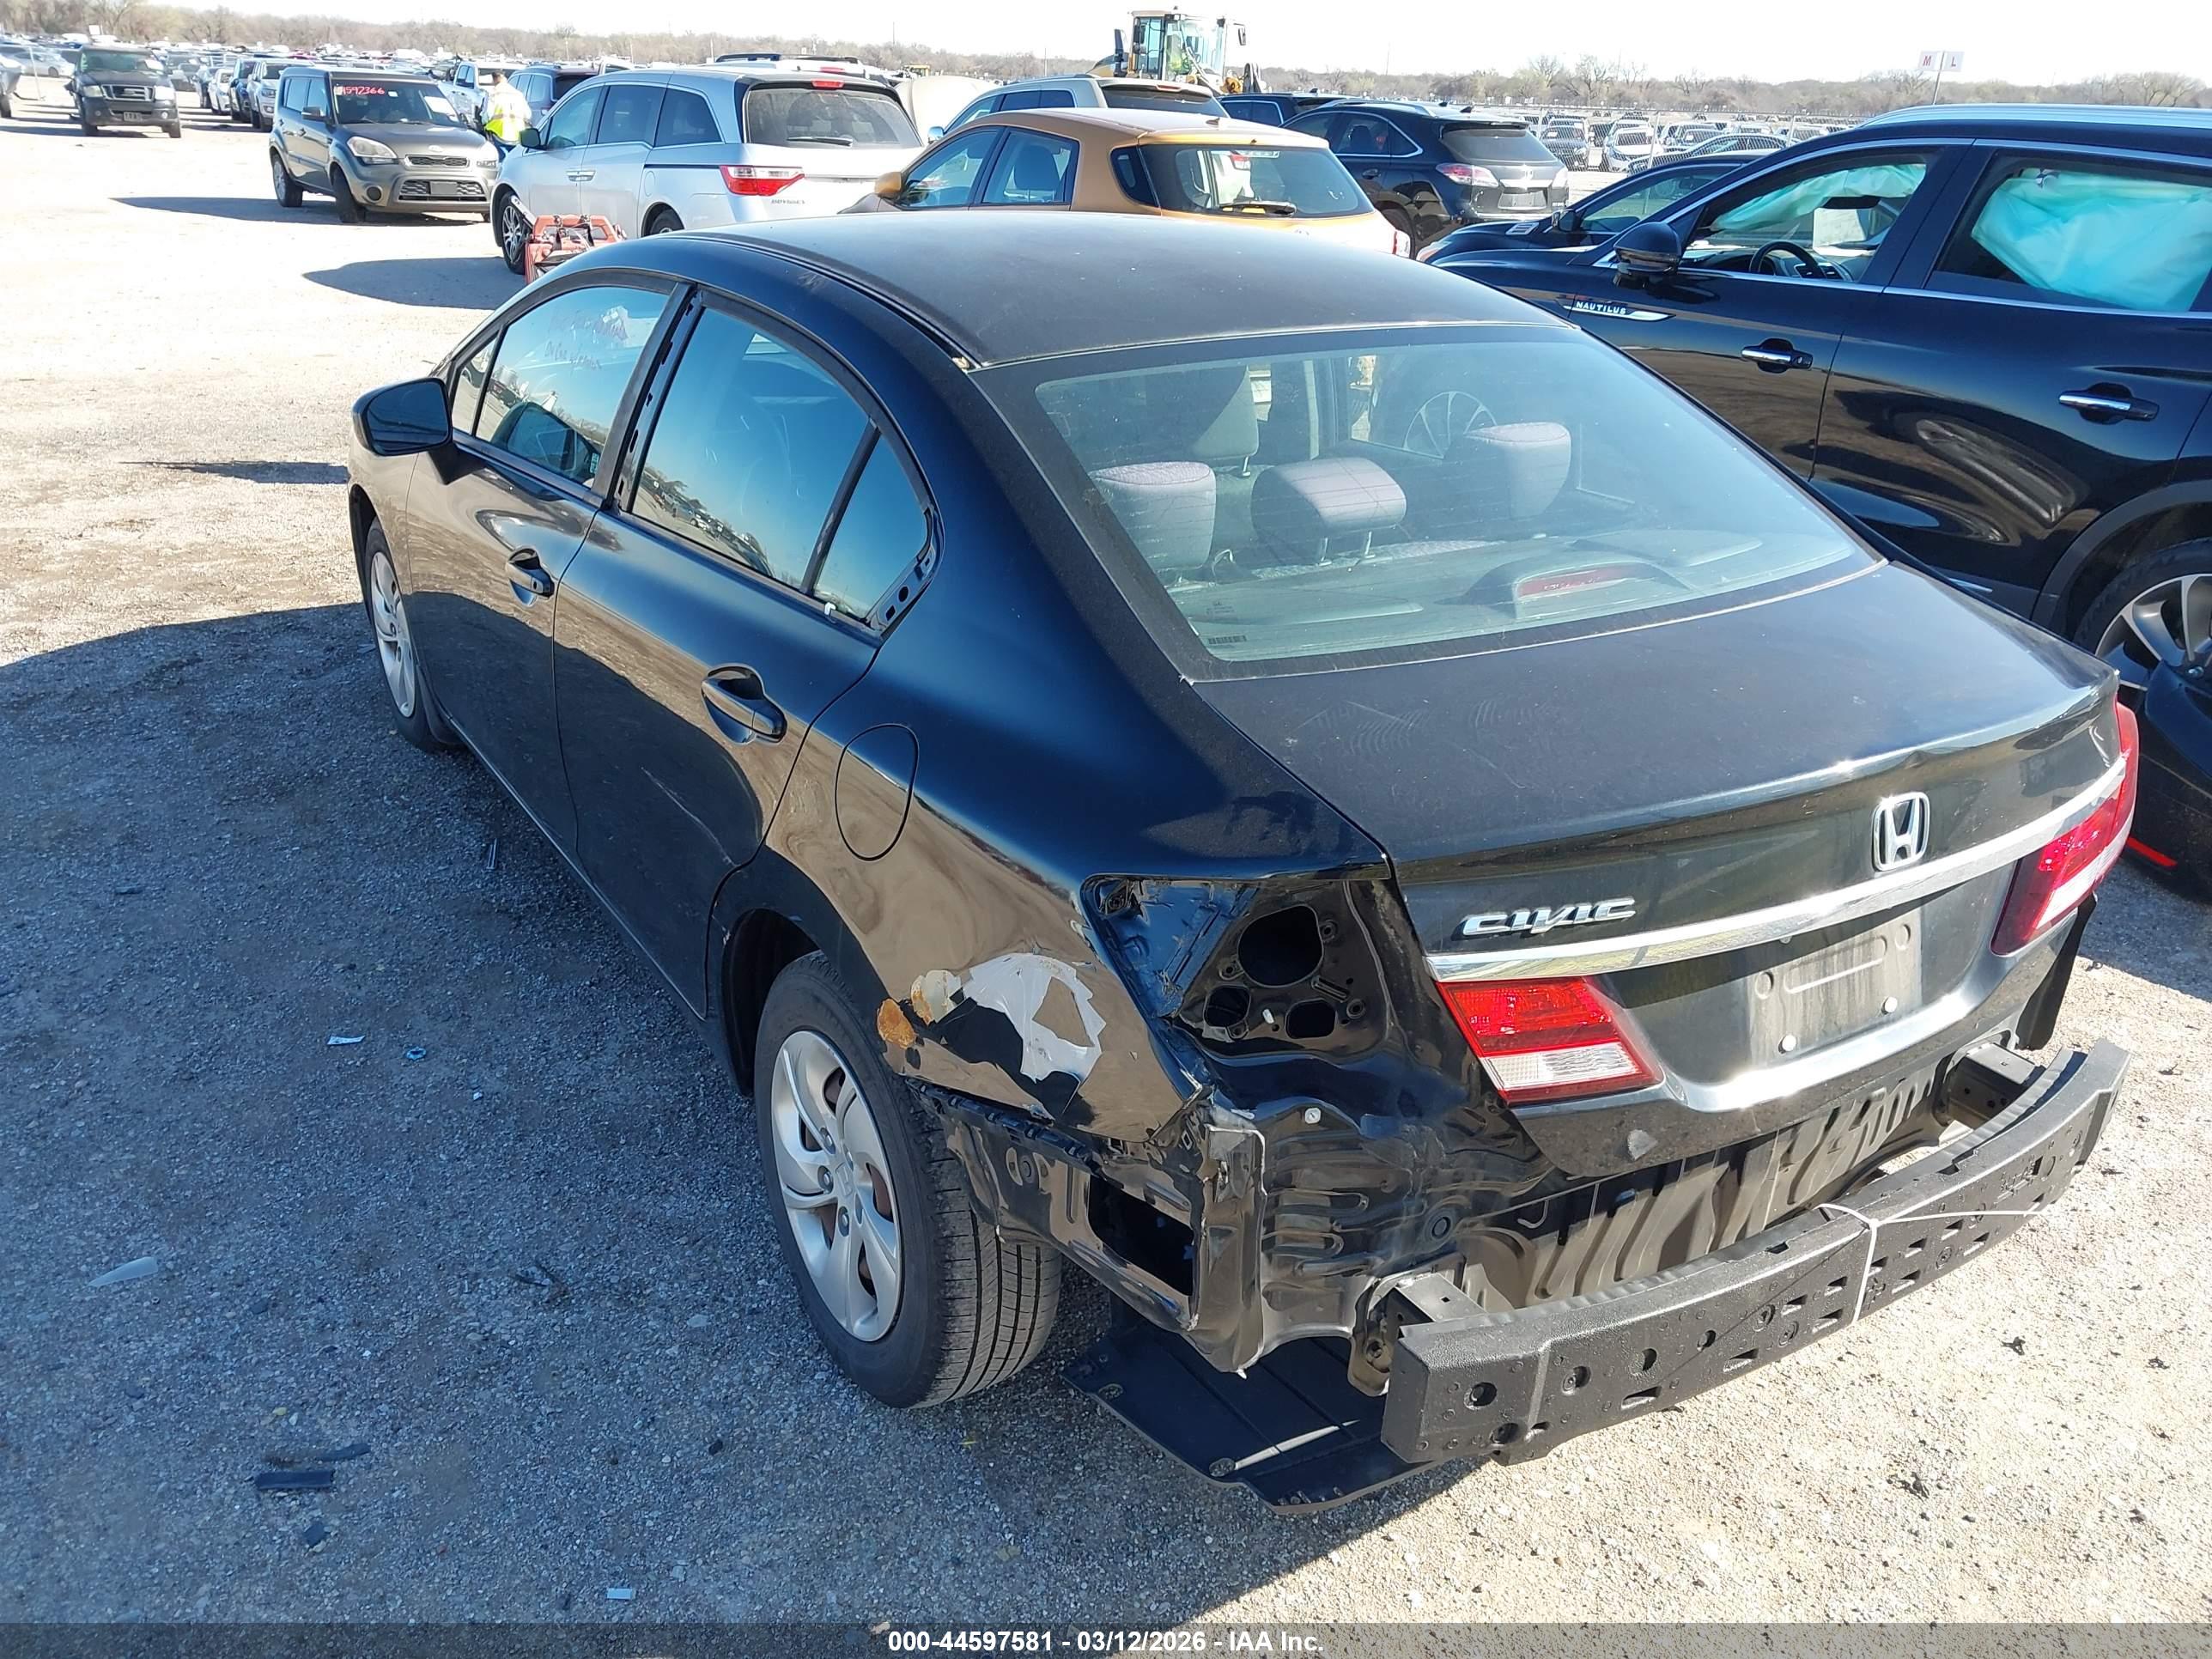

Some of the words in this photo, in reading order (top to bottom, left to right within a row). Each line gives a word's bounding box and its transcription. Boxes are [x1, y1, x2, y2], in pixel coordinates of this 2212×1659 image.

[1923, 55, 1932, 66] M
[1950, 56, 1957, 67] L
[1576, 301, 1626, 314] NAUTILUS
[1462, 897, 1637, 935] CIVIC
